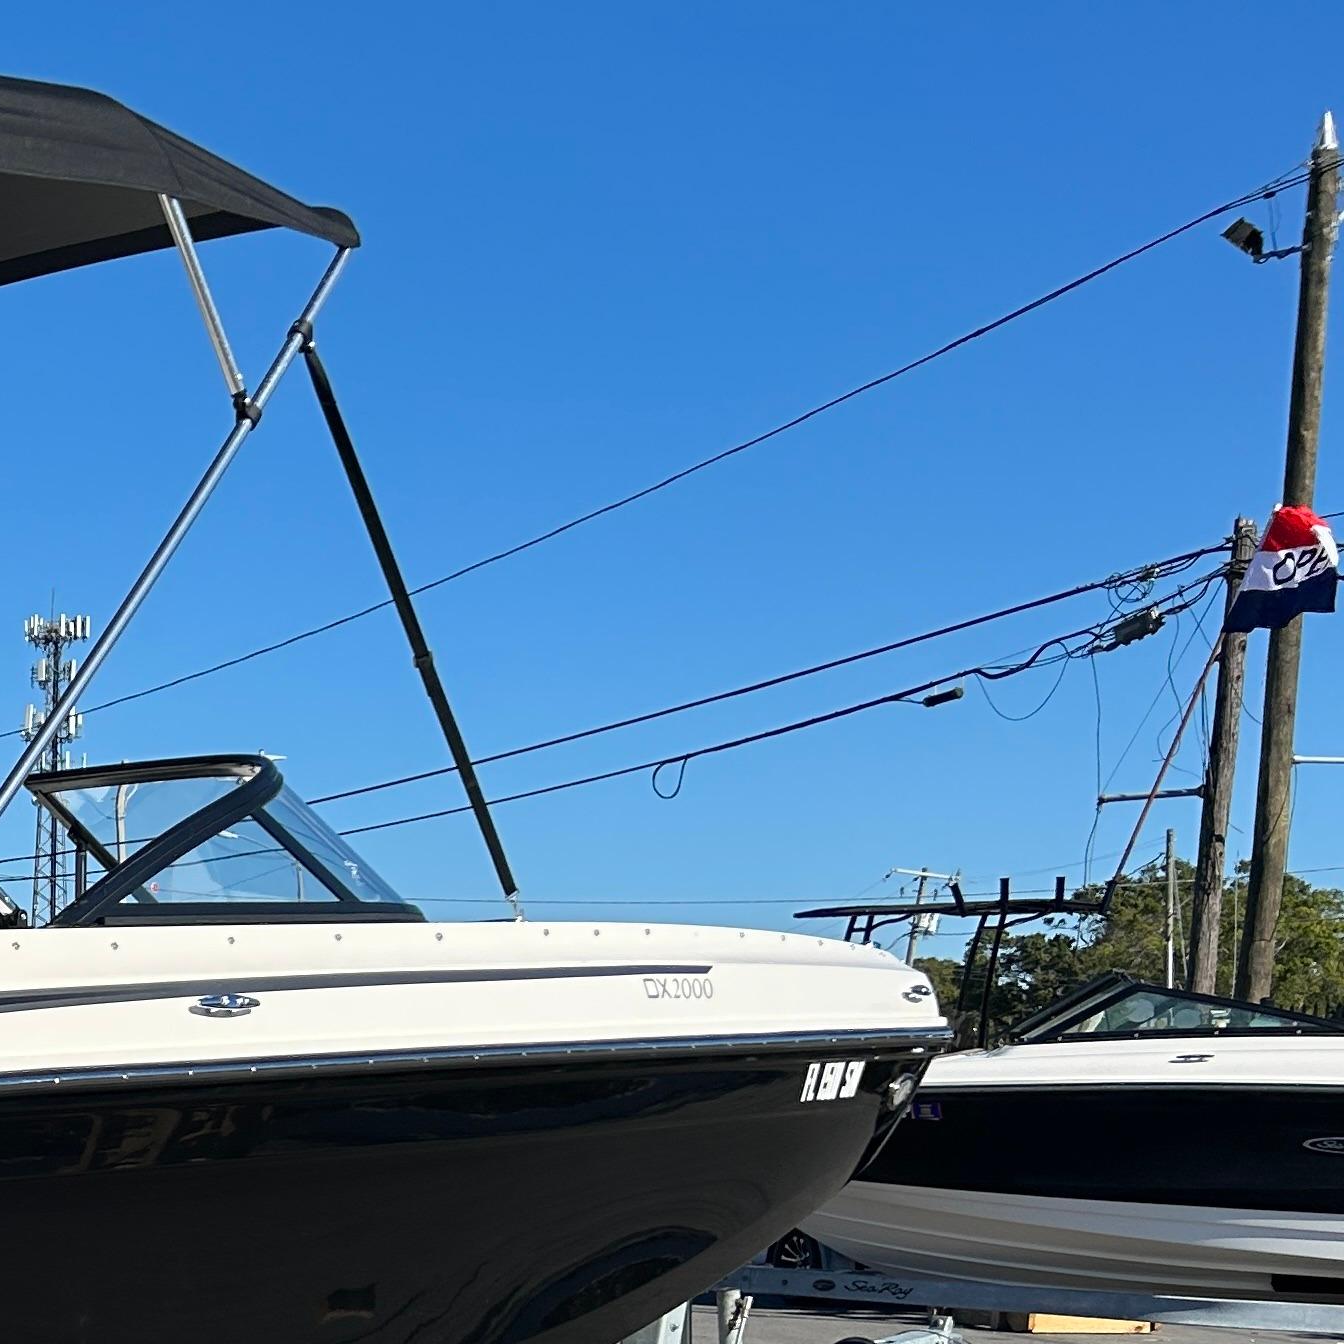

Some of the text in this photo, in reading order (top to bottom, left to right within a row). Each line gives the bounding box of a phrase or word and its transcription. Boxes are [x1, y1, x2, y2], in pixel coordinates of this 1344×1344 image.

[641, 978, 714, 999] DX2000
[844, 1280, 914, 1300] Sea Ray
